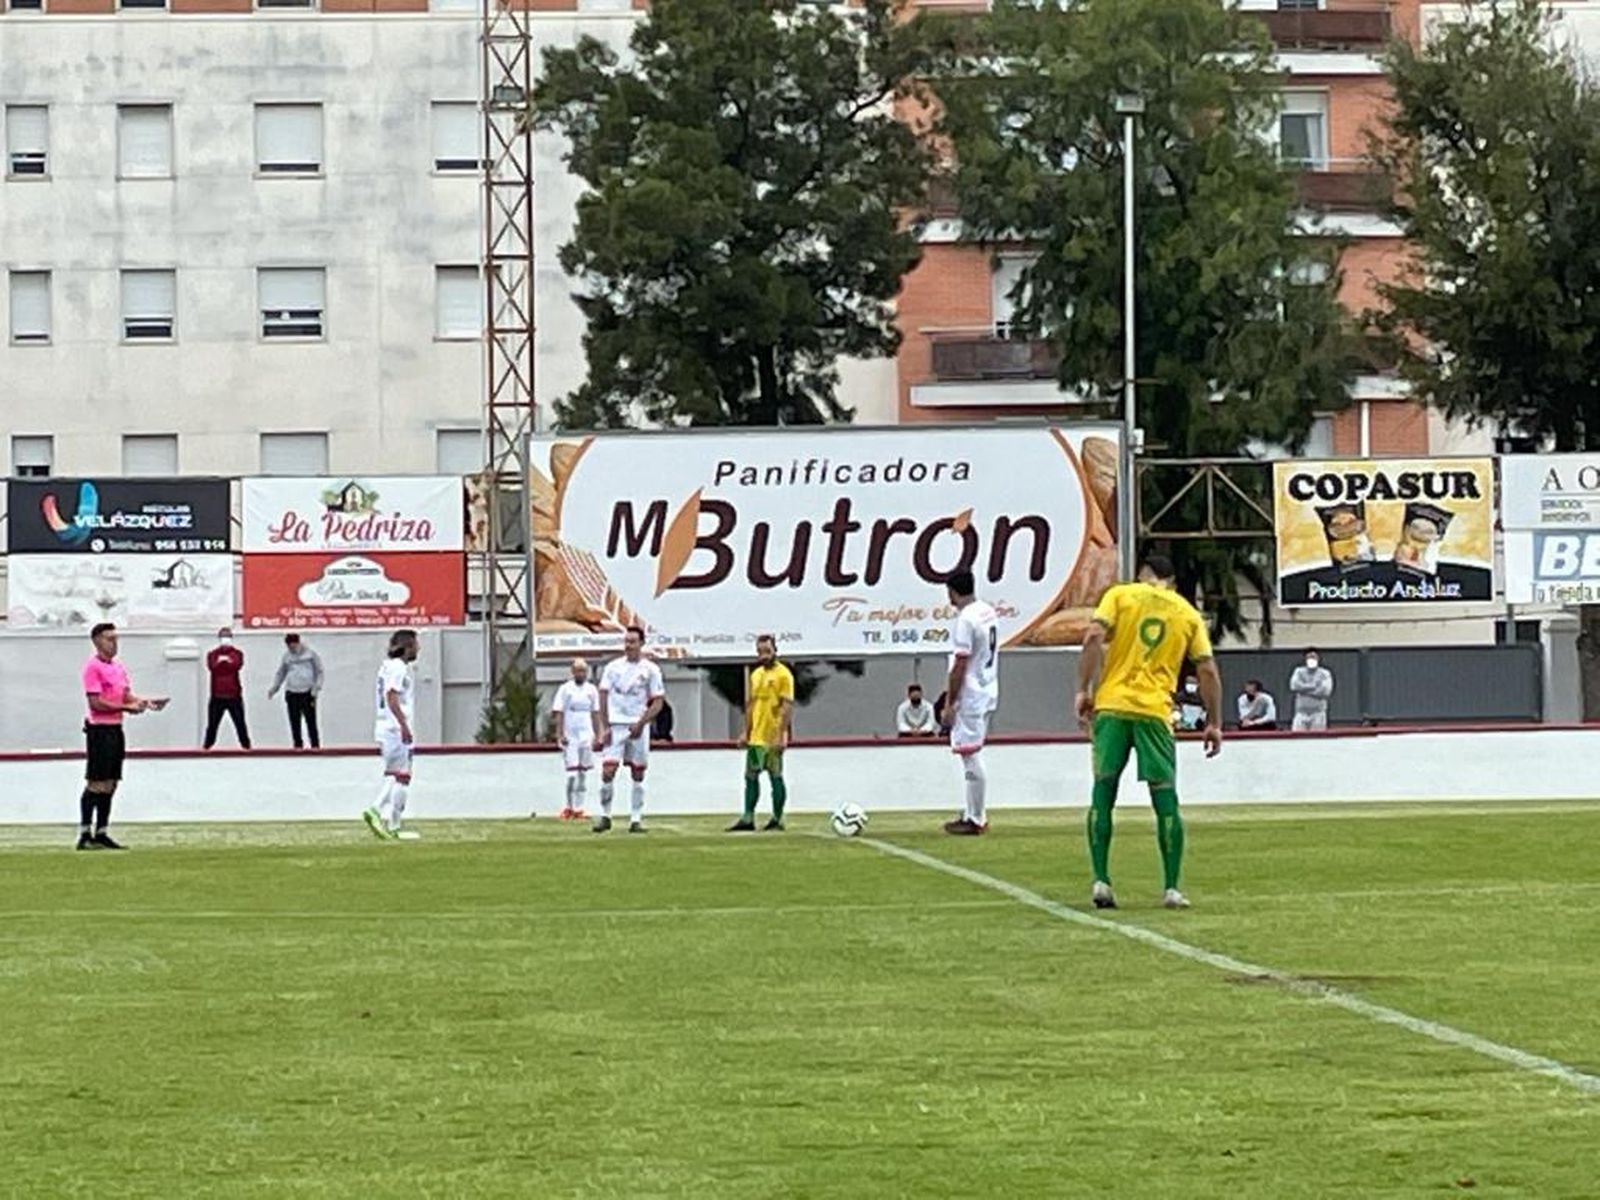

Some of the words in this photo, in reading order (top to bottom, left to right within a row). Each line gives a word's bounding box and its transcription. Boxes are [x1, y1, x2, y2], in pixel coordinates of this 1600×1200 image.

[713, 457, 972, 487] Panificadora
[1288, 472, 1481, 500] COPASUR
[73, 511, 192, 529] VELÁZQUEZ
[268, 511, 313, 543] La
[321, 510, 436, 543] Pedriza
[1308, 579, 1387, 600] Producto
[1389, 576, 1462, 599] Andaluz
[868, 603, 928, 627] mejor
[1140, 617, 1166, 663] 9
